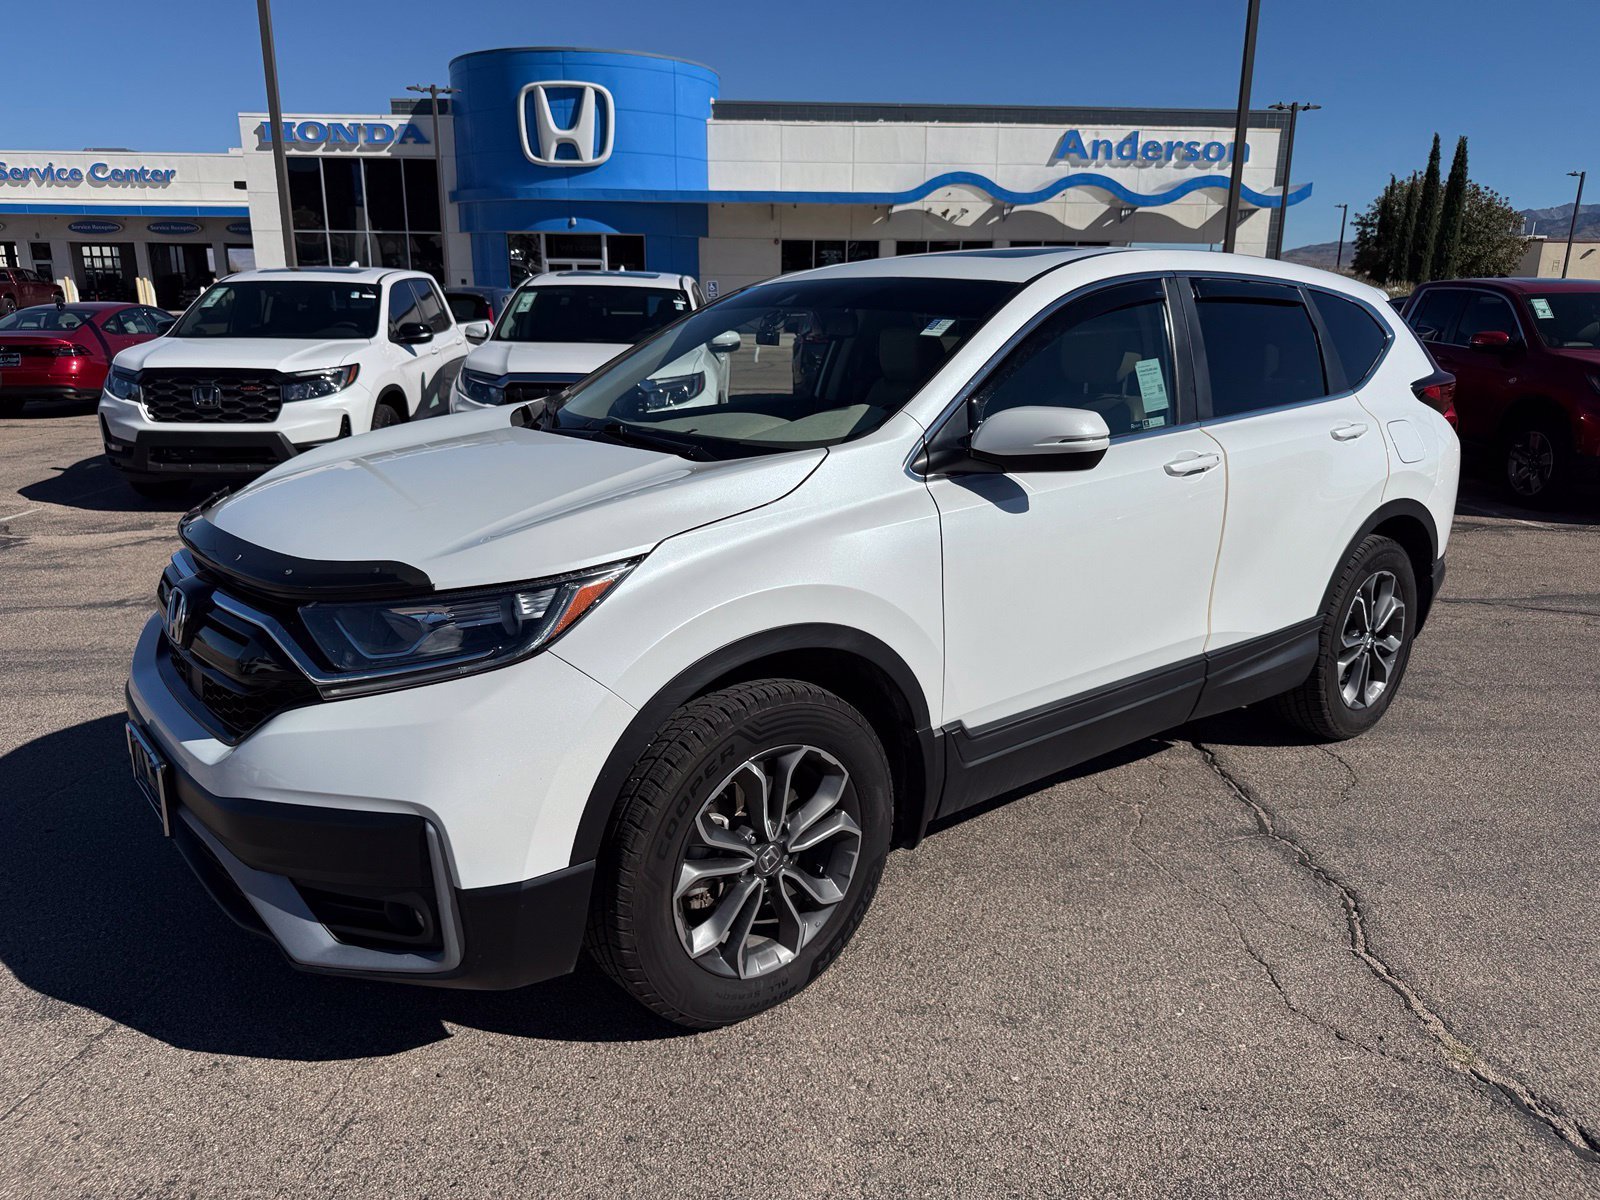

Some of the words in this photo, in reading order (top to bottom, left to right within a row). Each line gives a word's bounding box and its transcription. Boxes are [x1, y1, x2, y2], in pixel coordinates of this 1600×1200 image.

[260, 121, 430, 144] HONDA
[1055, 129, 1250, 162] Anderson
[0, 162, 83, 182] Service
[90, 162, 176, 182] Center
[657, 743, 736, 860] COOPER
